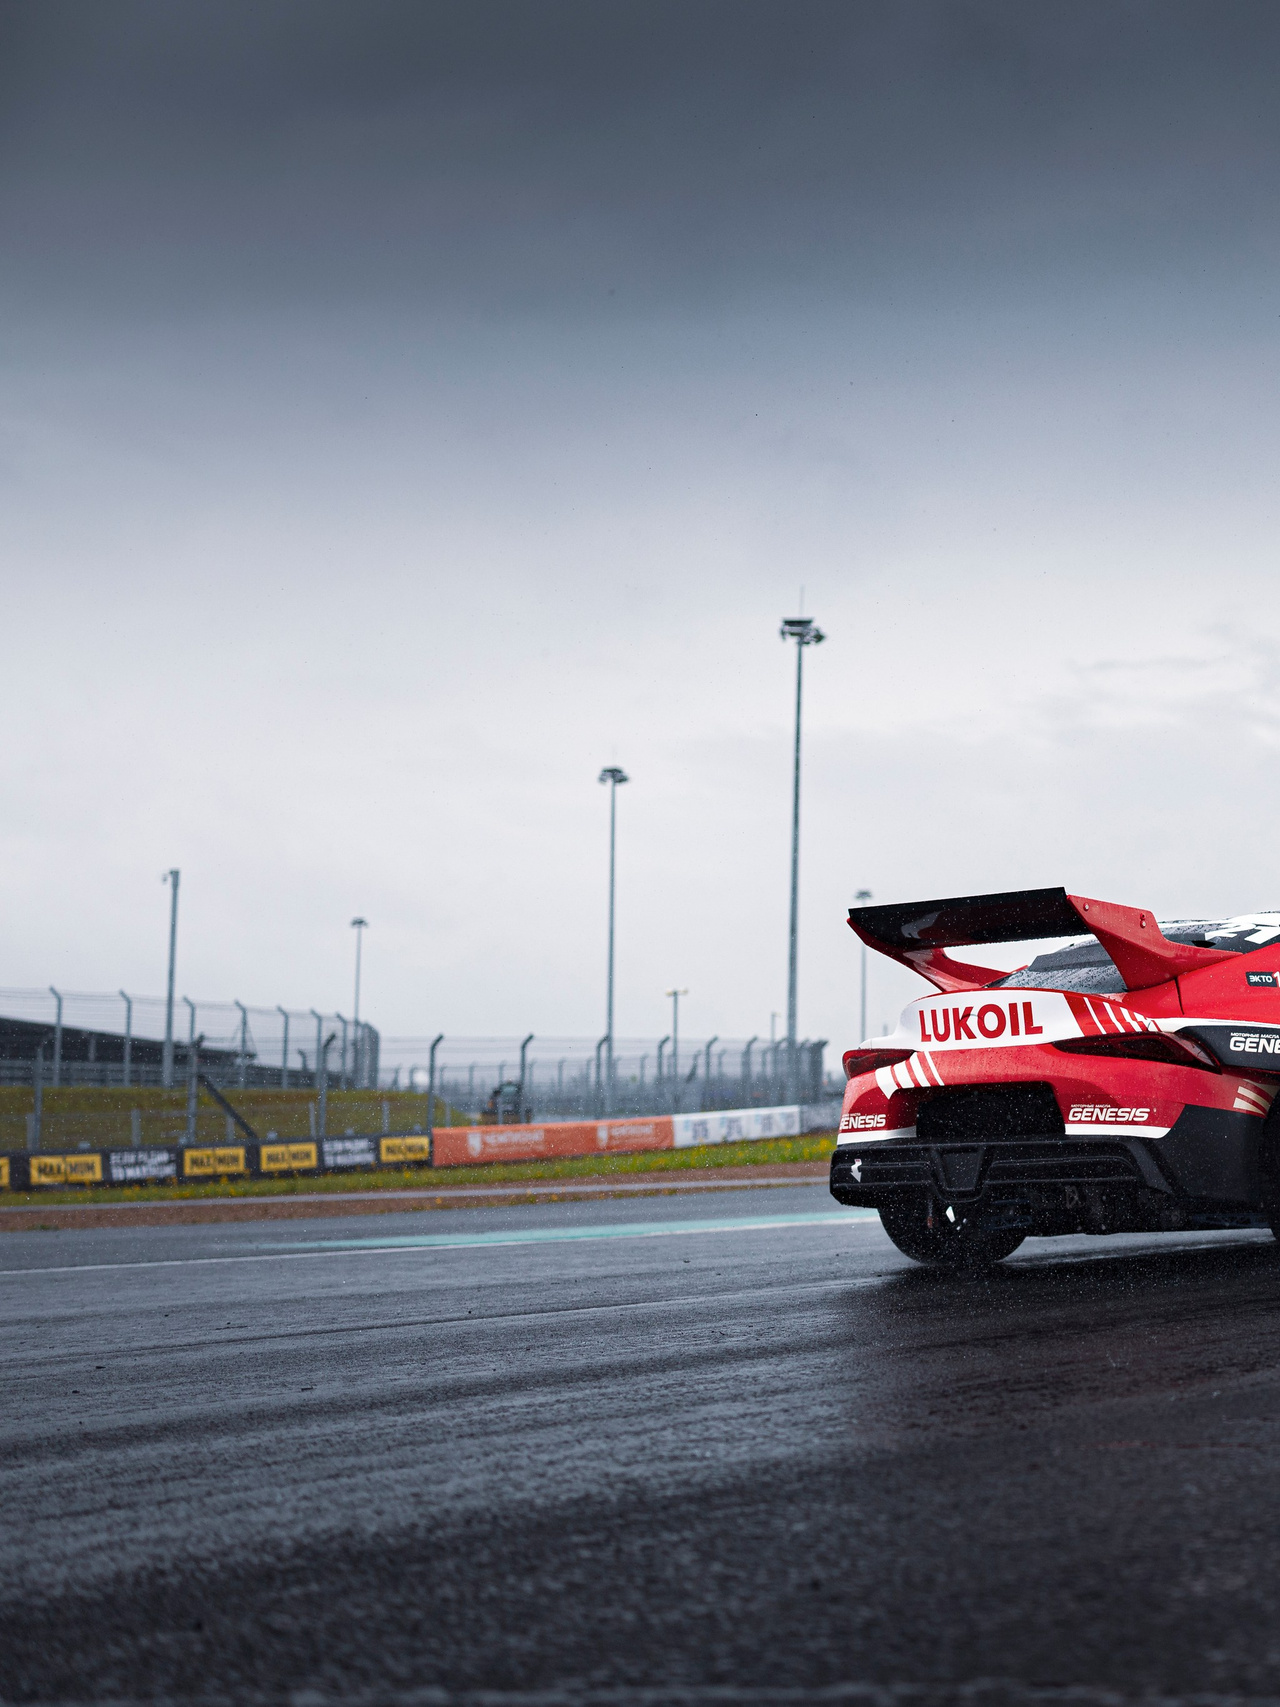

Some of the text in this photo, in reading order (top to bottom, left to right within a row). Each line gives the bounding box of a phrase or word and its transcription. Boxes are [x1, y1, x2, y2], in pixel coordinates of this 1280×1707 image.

[1249, 974, 1273, 985] ЭКТО
[918, 1001, 1043, 1043] LUKOIL
[1068, 1107, 1151, 1122] GENESIS
